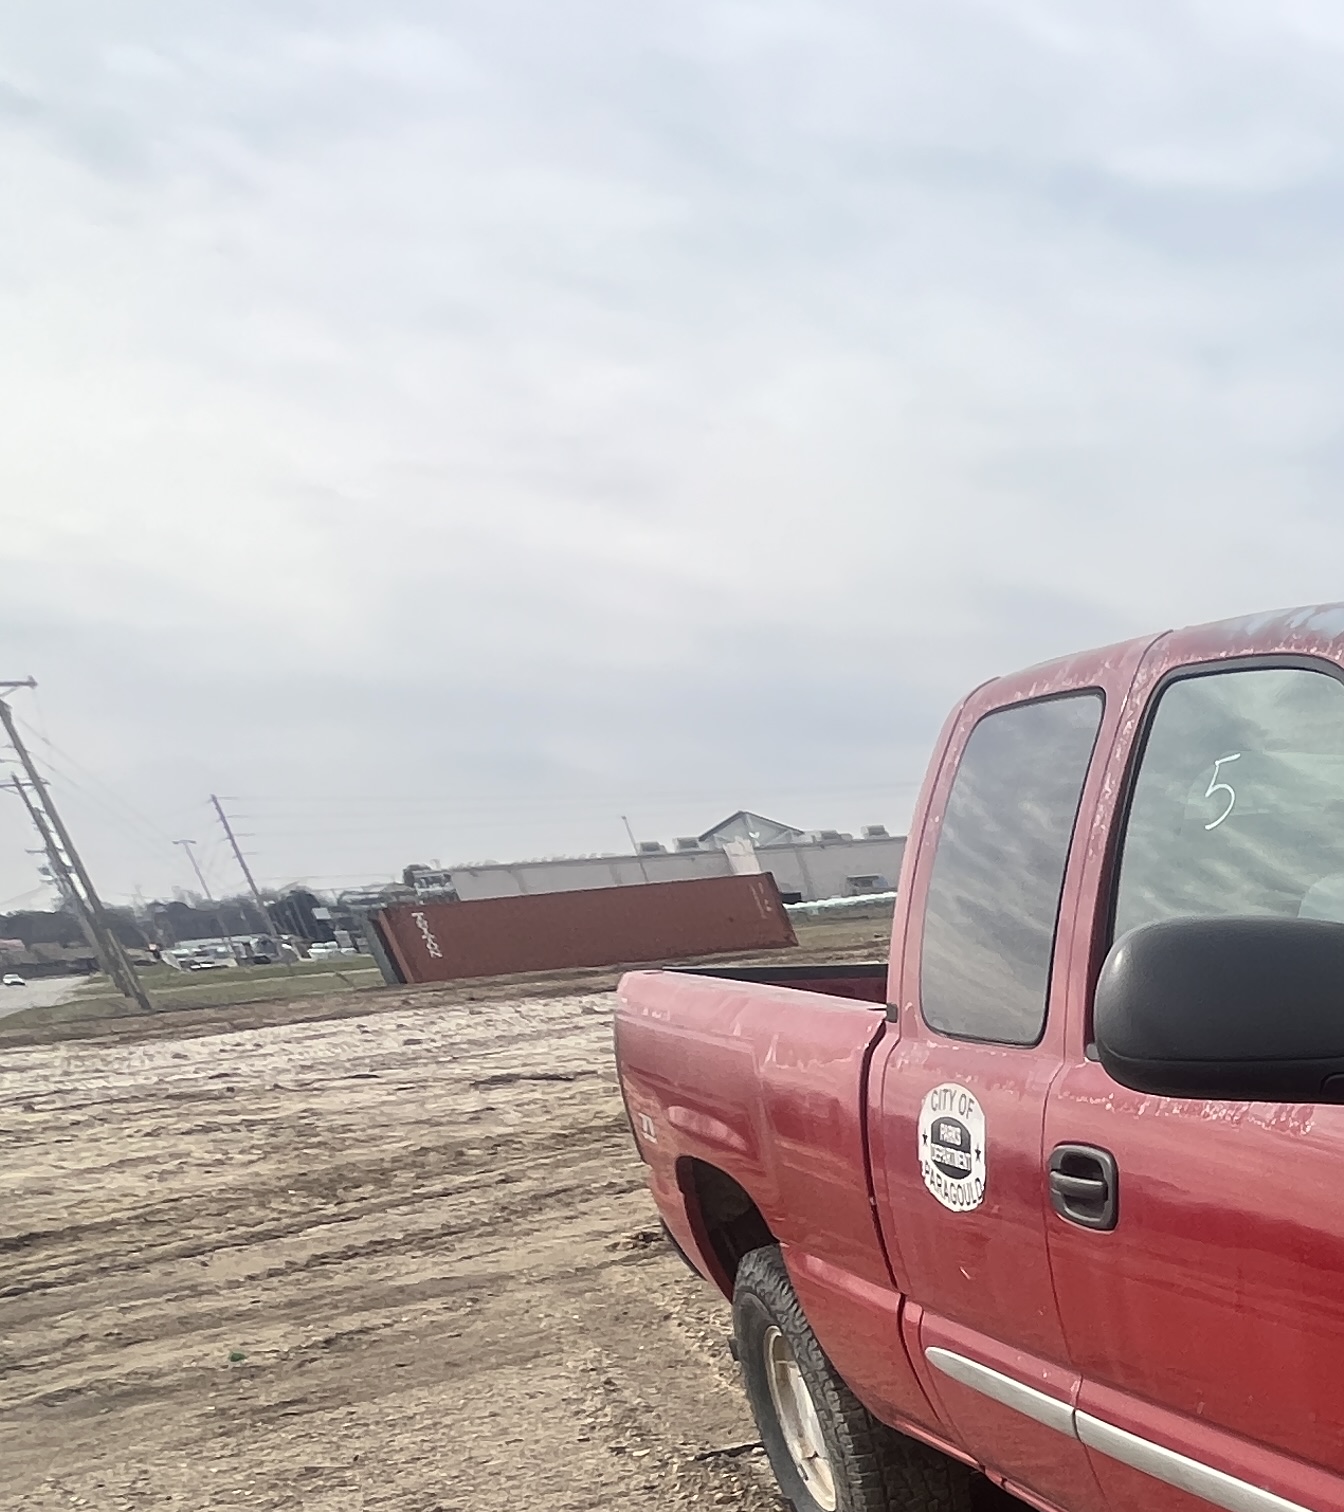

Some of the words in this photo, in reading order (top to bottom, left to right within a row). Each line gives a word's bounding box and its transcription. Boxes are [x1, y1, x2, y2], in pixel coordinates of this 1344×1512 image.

[1204, 752, 1241, 831] 5
[930, 1088, 957, 1112] CITY
[958, 1093, 975, 1119] OF
[924, 1159, 983, 1207] PARAGOULD
